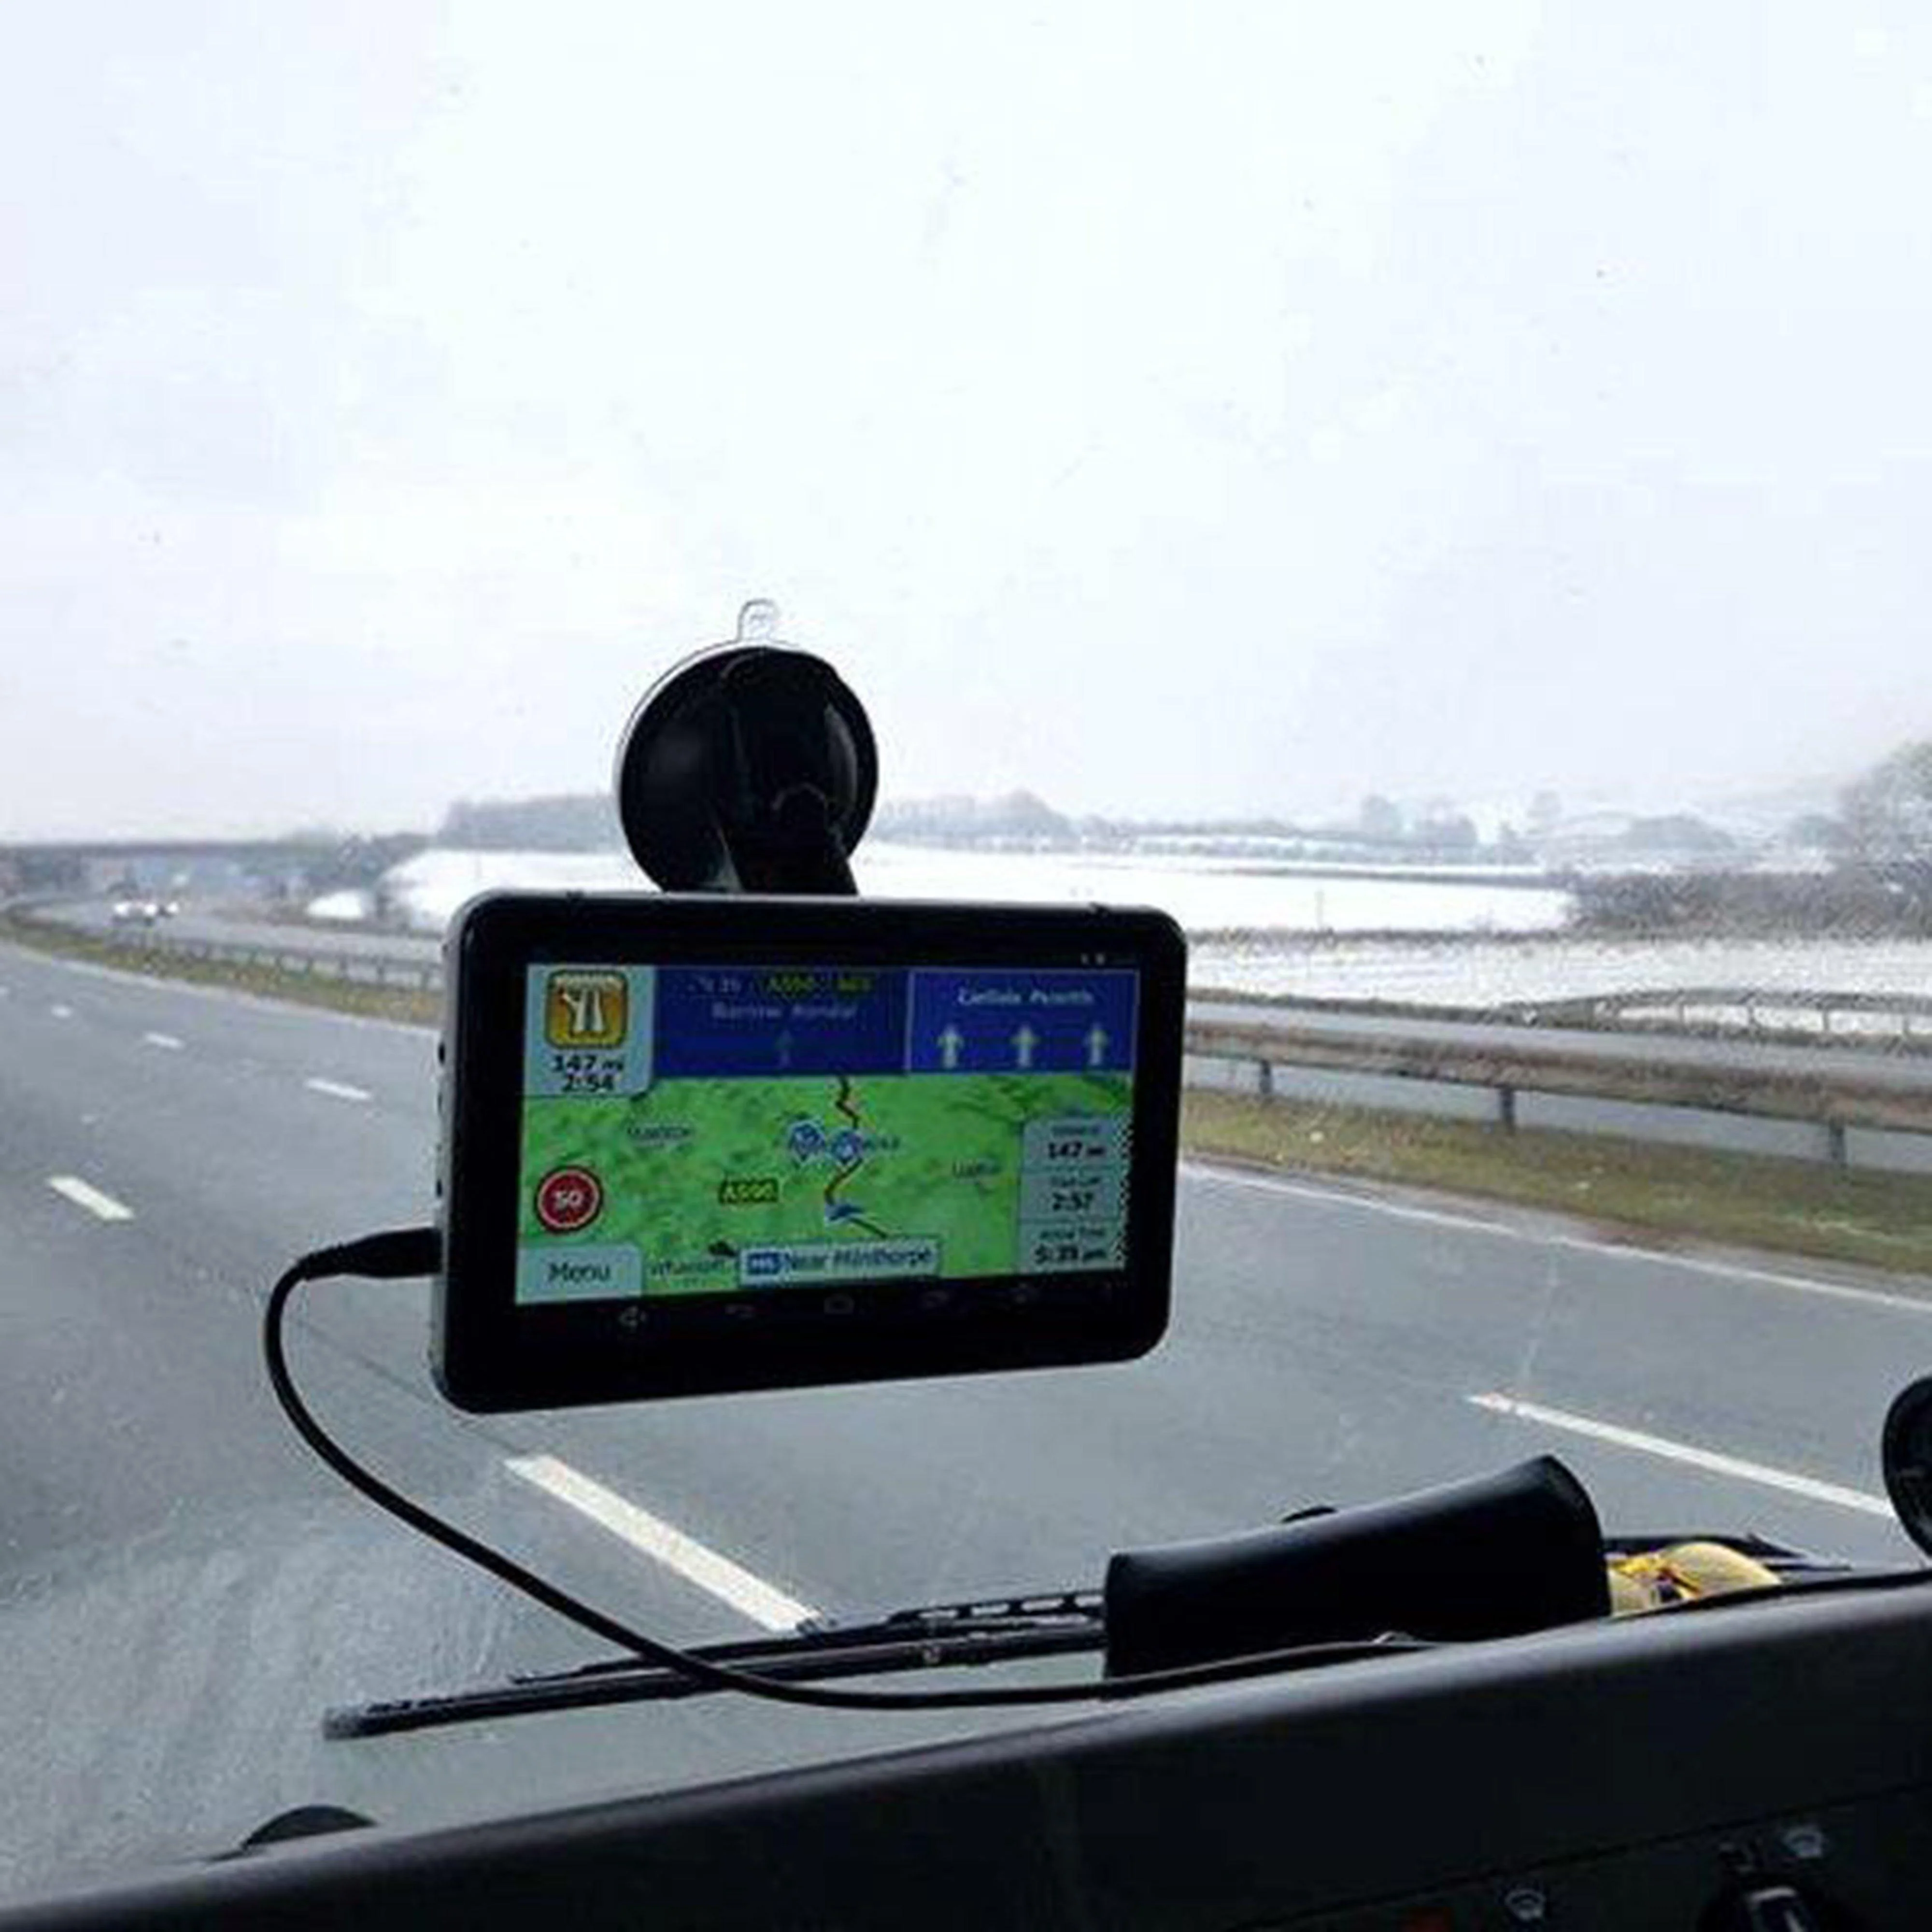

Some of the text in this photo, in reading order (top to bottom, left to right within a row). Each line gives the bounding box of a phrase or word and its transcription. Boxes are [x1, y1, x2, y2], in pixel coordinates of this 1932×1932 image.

[552, 1054, 597, 1072] 147
[1047, 1141, 1083, 1159] 147
[546, 1261, 611, 1284] Menu
